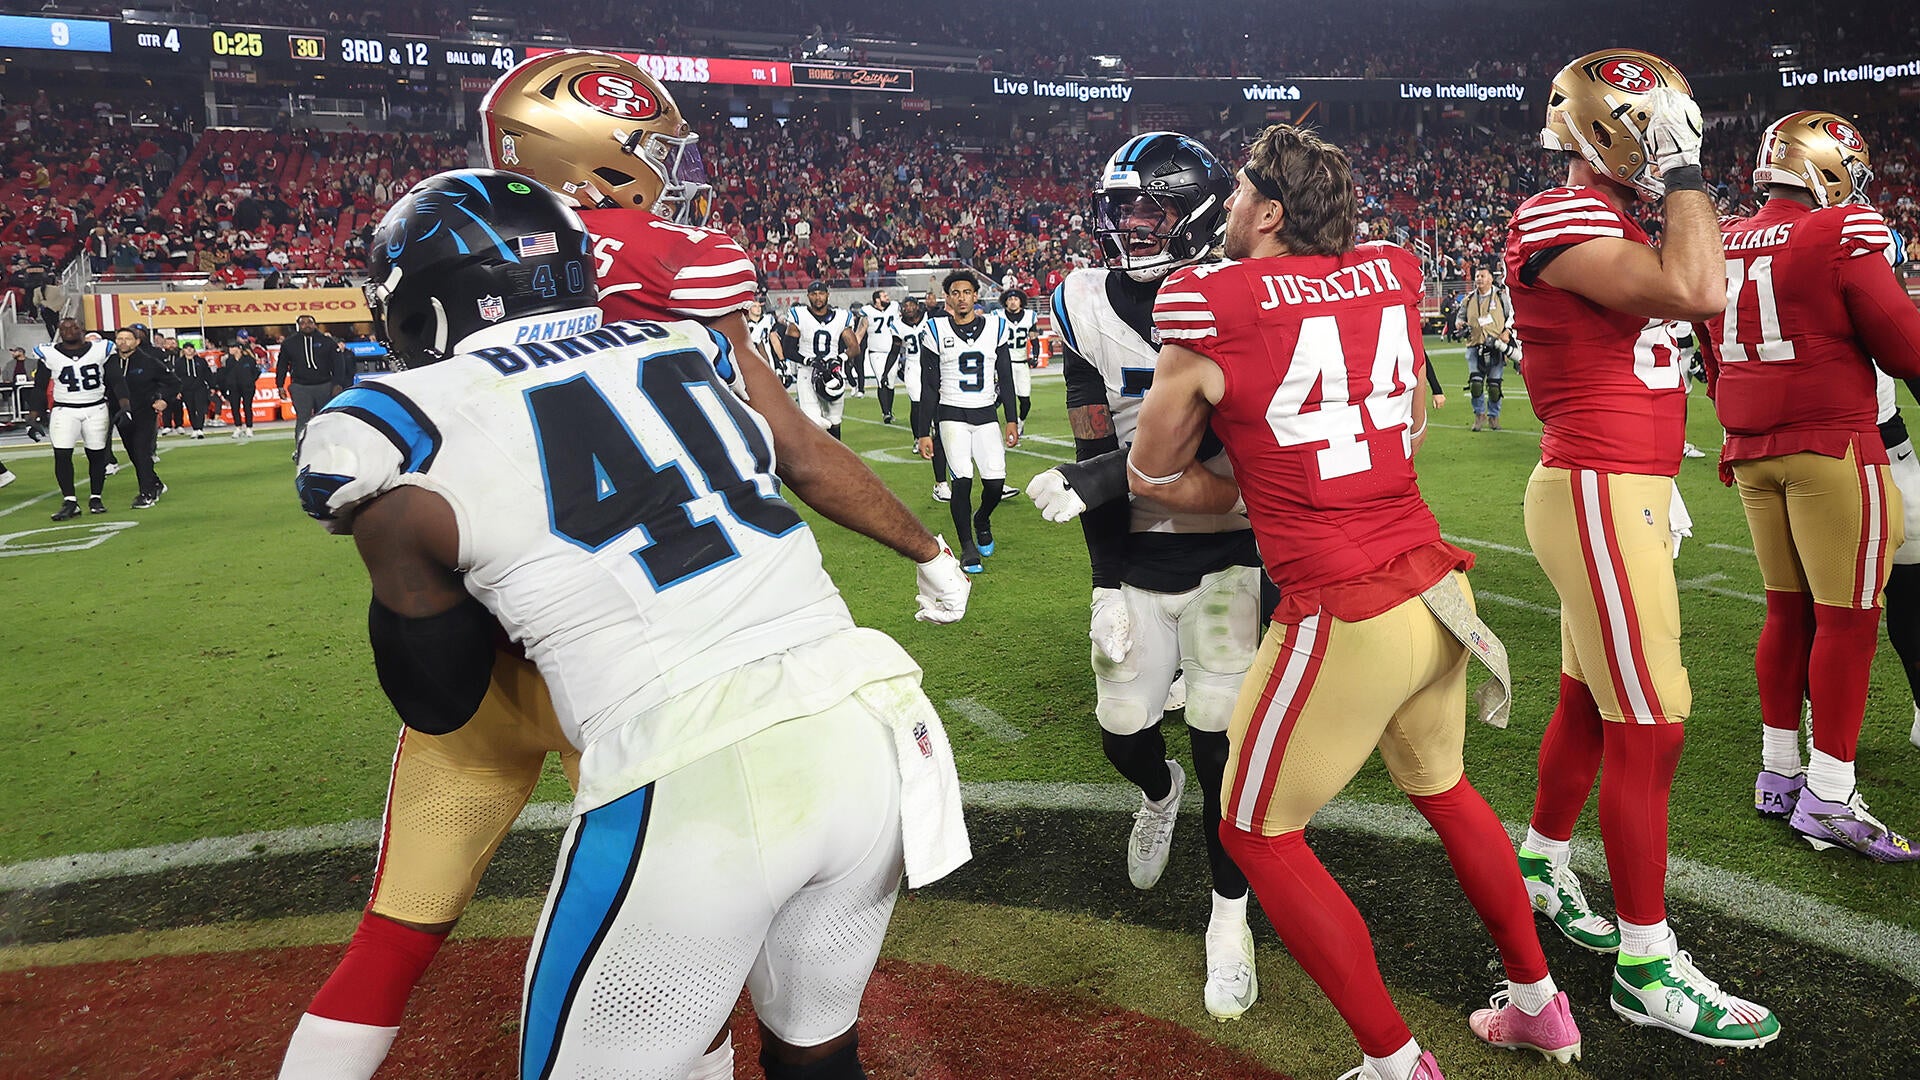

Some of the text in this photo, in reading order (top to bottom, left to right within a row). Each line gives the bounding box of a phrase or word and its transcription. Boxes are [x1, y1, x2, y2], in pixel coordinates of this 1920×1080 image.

[51, 22, 69, 46] 9
[138, 29, 180, 52] QTR 4
[213, 31, 262, 56] 0:25
[297, 39, 318, 57] 30
[342, 39, 428, 66] 3RD & 12
[447, 48, 514, 69] BALL ON 43
[752, 67, 777, 83] TOL 1
[808, 68, 834, 80] HOME
[850, 70, 899, 88] Faithful
[1612, 62, 1651, 89] SF
[1782, 60, 1920, 87] Live Intelligentl
[597, 76, 649, 114] SF
[993, 78, 1132, 101] Live Intelligently
[1400, 83, 1525, 101] Live Intelligently
[1720, 223, 1795, 250] LLIAMS
[533, 261, 585, 298] 40
[1260, 258, 1402, 311] JUSZCZYK
[140, 299, 357, 316] SAN FRANCISCO
[484, 307, 503, 318] NFL
[1719, 255, 1796, 362] 71
[515, 314, 598, 344] PANTHERS
[474, 319, 671, 376] BARNES
[813, 329, 831, 359] 0
[58, 363, 101, 392] 48
[958, 351, 985, 393] 9
[1264, 304, 1418, 481] 44
[522, 347, 807, 594] 40
